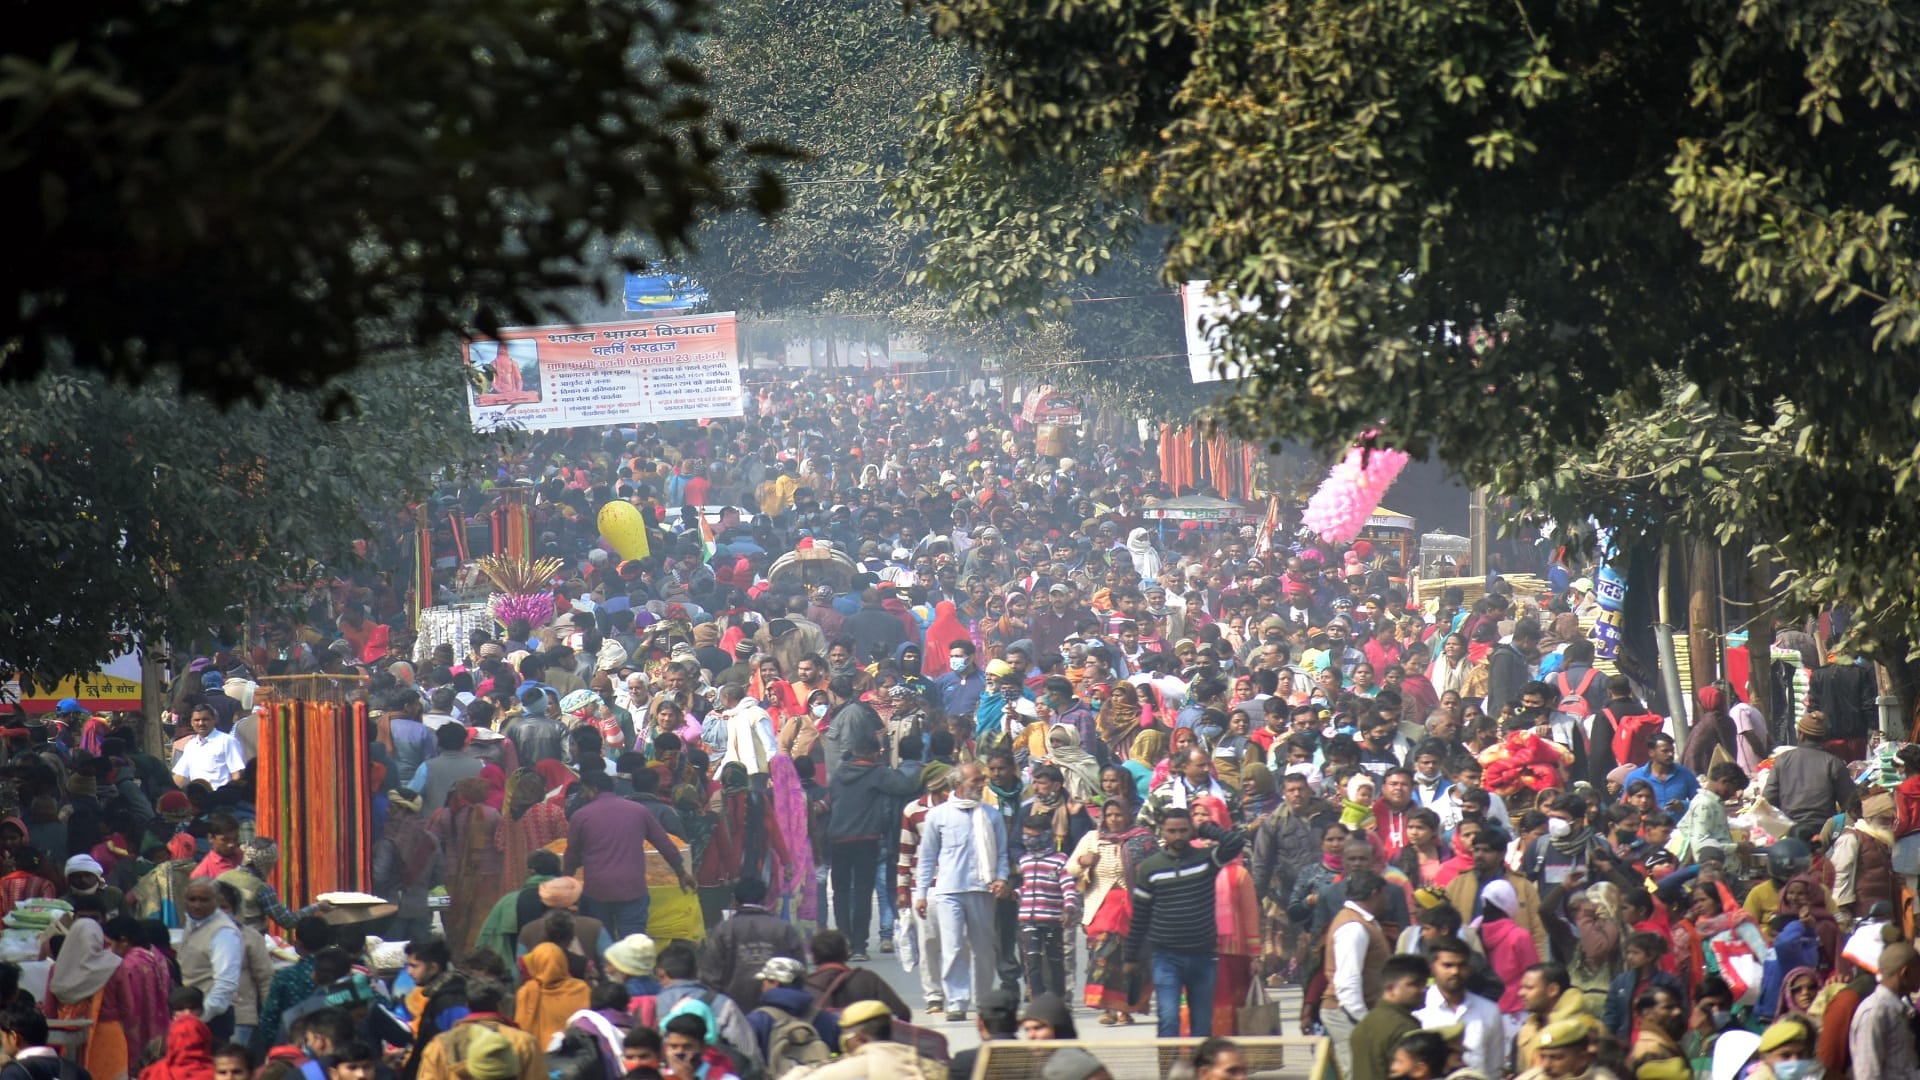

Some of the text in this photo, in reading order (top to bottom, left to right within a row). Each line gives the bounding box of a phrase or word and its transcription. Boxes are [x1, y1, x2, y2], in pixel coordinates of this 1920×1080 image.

[548, 323, 717, 343] भारत भाग्य विधाता
[592, 341, 676, 356] महर्षि भरद्वाज
[675, 353, 690, 362] 23
[102, 683, 112, 694] की
[116, 683, 136, 694] सोच
